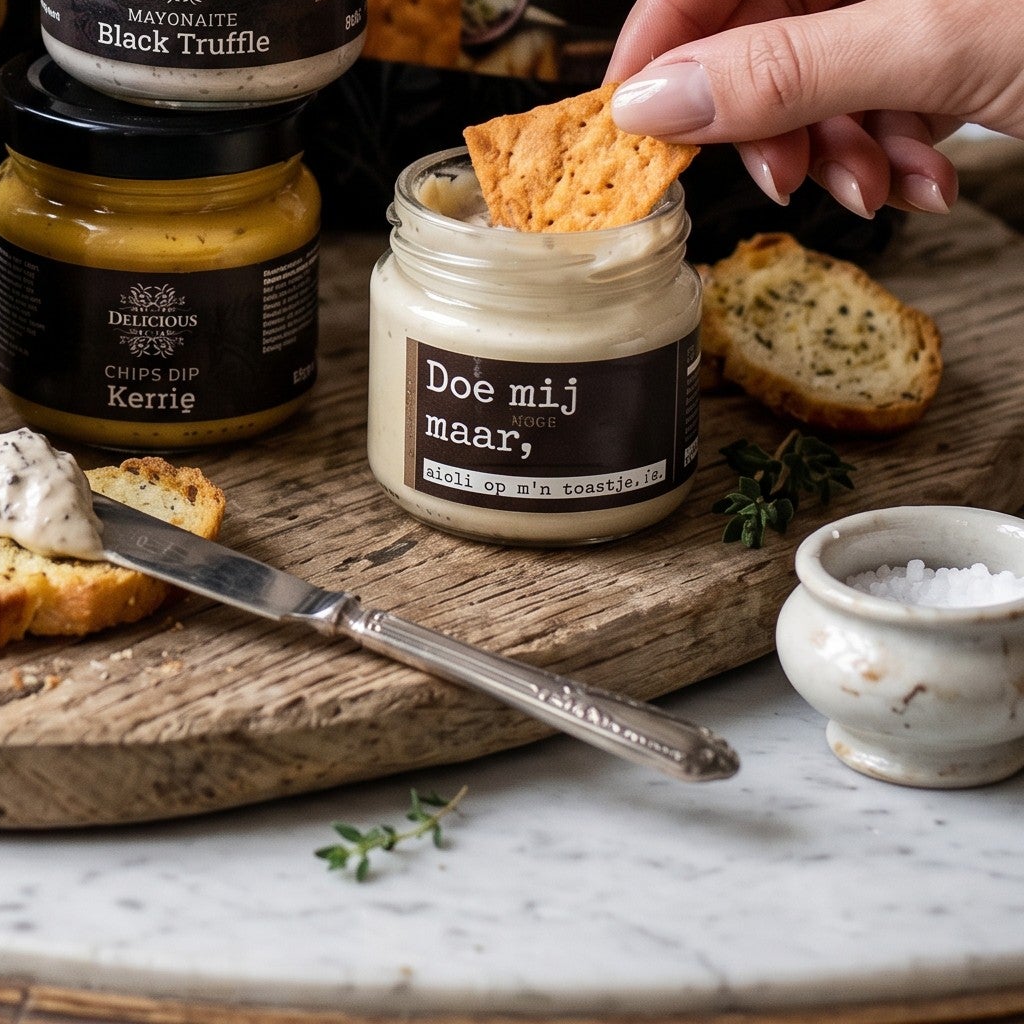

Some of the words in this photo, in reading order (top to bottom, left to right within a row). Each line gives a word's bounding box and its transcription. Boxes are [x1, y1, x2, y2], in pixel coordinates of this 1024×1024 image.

[127, 8, 238, 27] MAYONAITE
[98, 22, 170, 54] Black
[177, 30, 270, 56] Truffle
[108, 310, 198, 328] DELICIOUS
[104, 365, 162, 382] CHIPS
[168, 367, 200, 382] DIP
[426, 359, 495, 404] Doe
[508, 377, 578, 416] mij
[425, 413, 533, 460] maar,
[426, 466, 473, 488] aioli
[484, 480, 506, 495] op
[517, 484, 552, 495] m'n
